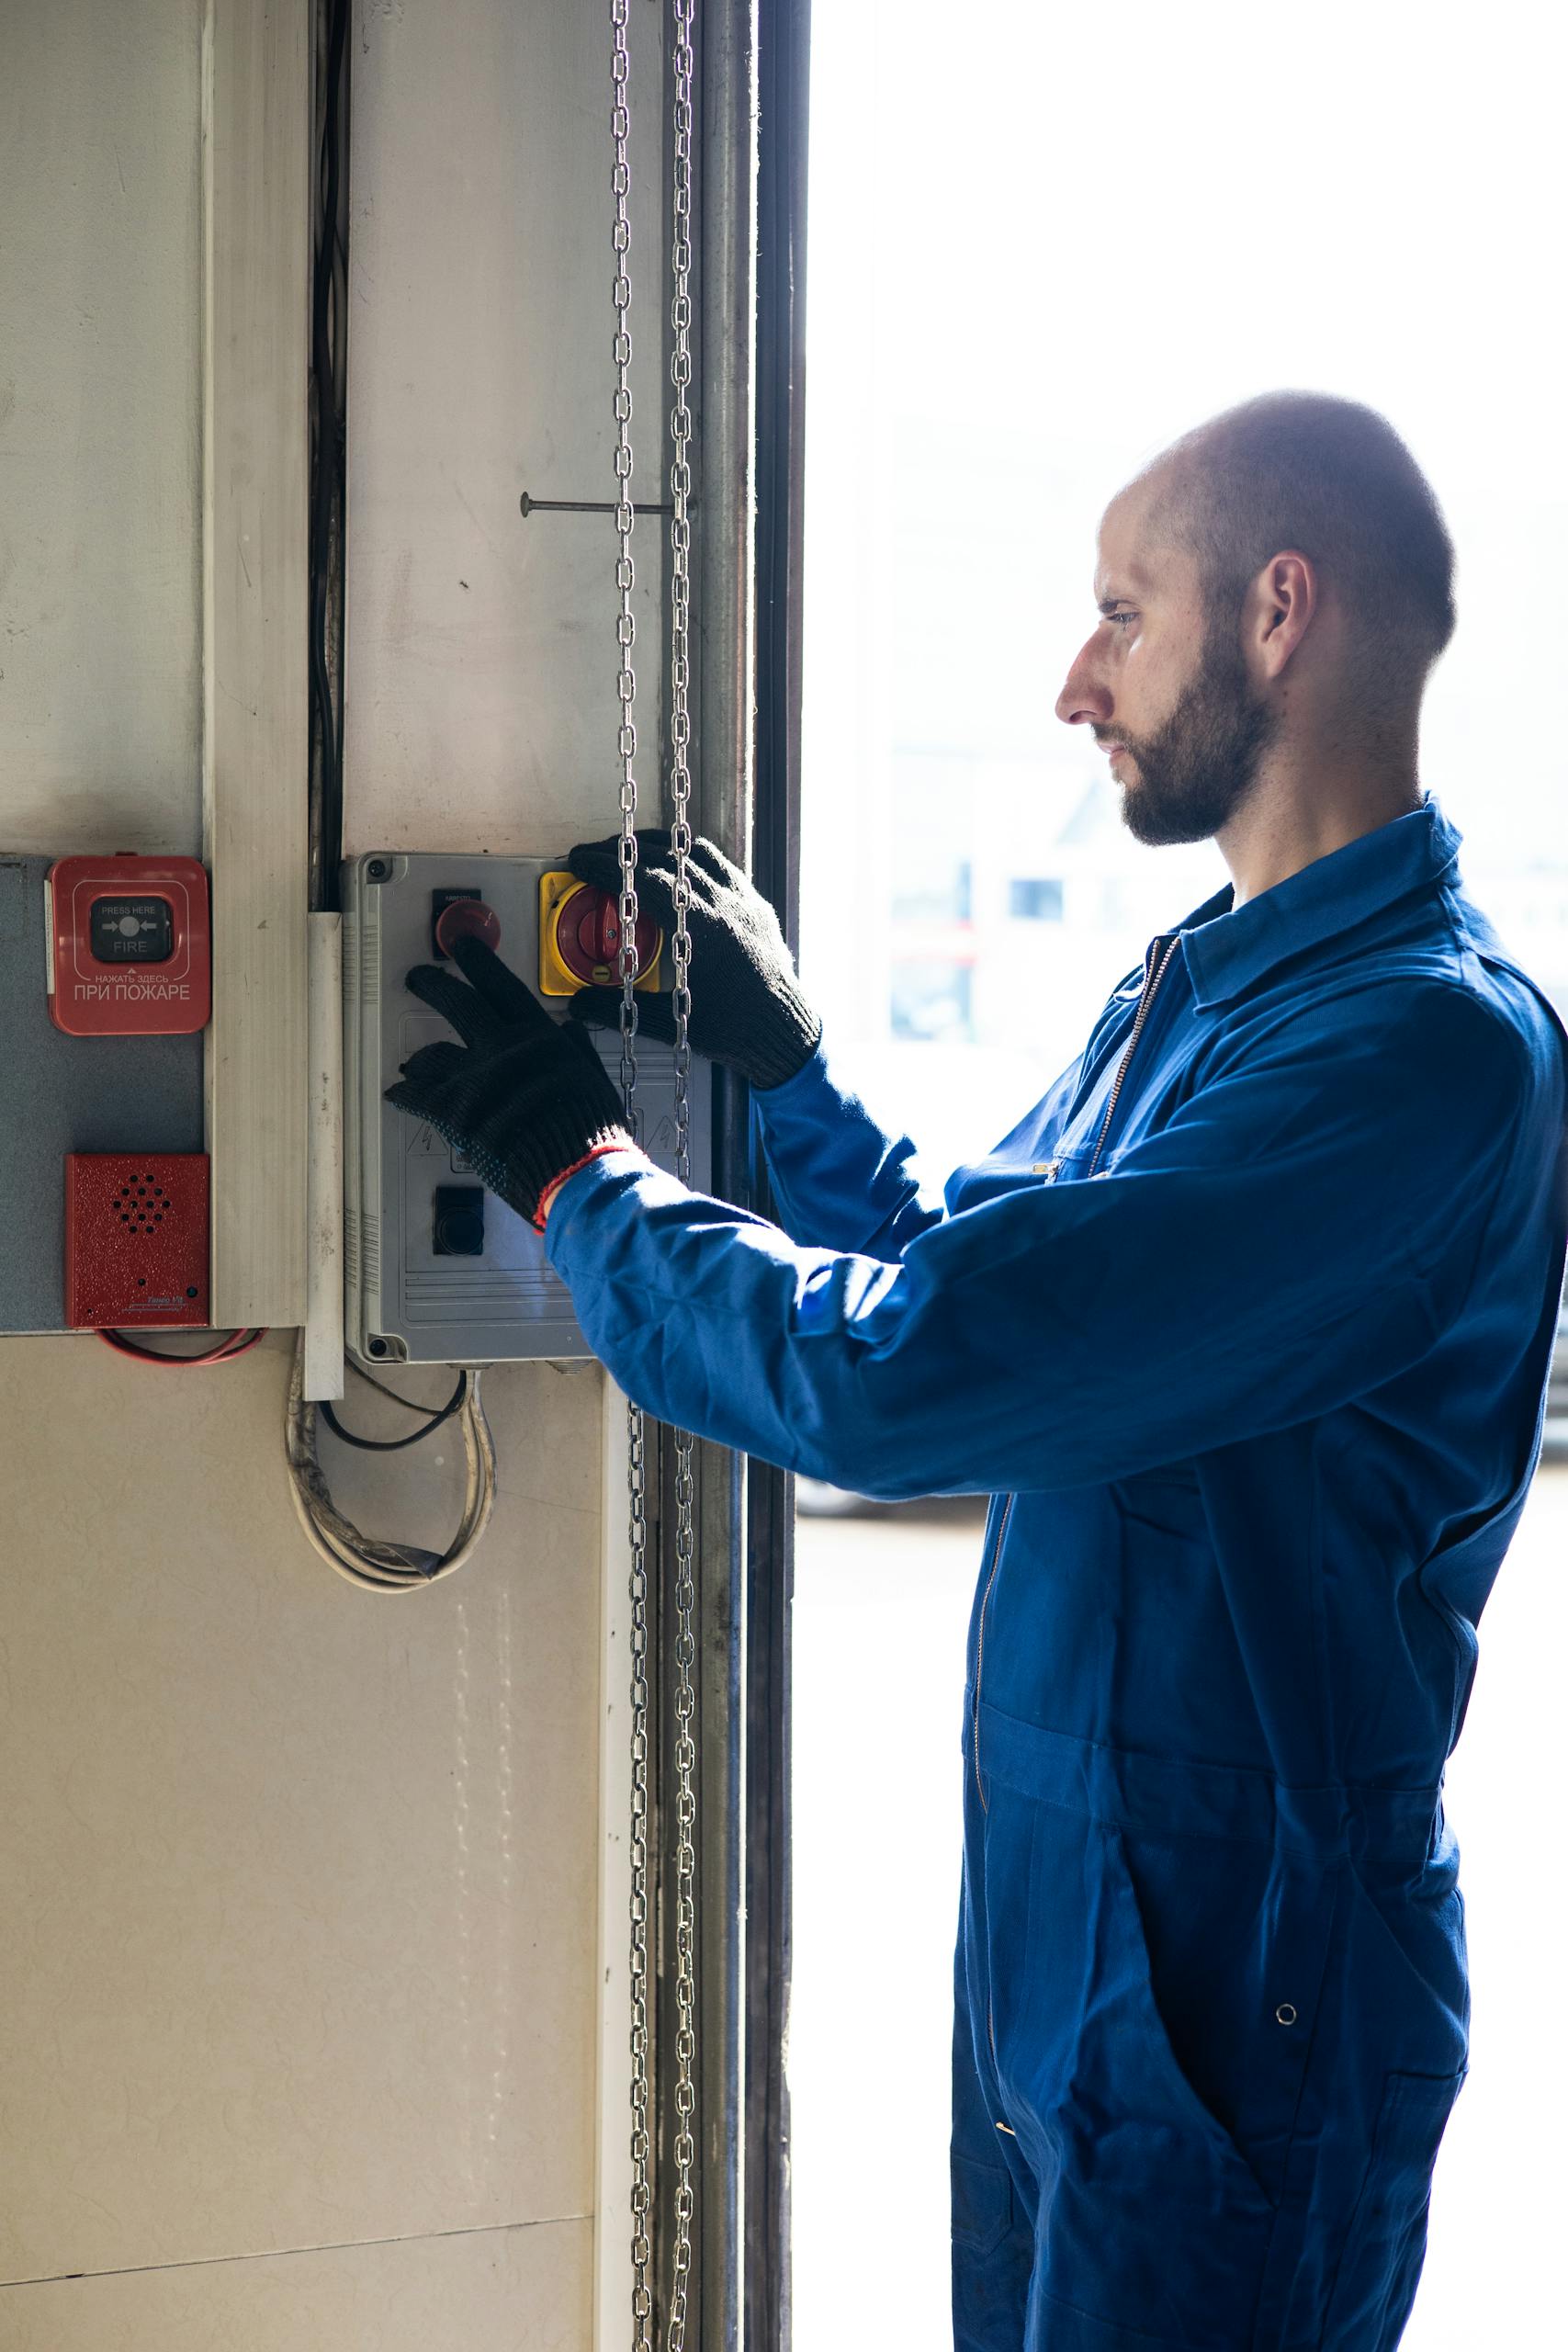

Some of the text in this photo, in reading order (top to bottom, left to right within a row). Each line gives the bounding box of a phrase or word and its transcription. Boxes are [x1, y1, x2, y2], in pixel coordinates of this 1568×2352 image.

[102, 906, 155, 915] PRESS HERE
[113, 941, 148, 953] FIRE
[96, 975, 169, 984] НАЖАТЬ ЗДЕСЬ
[74, 985, 190, 1001] ПРИ ПОЖАРЕ
